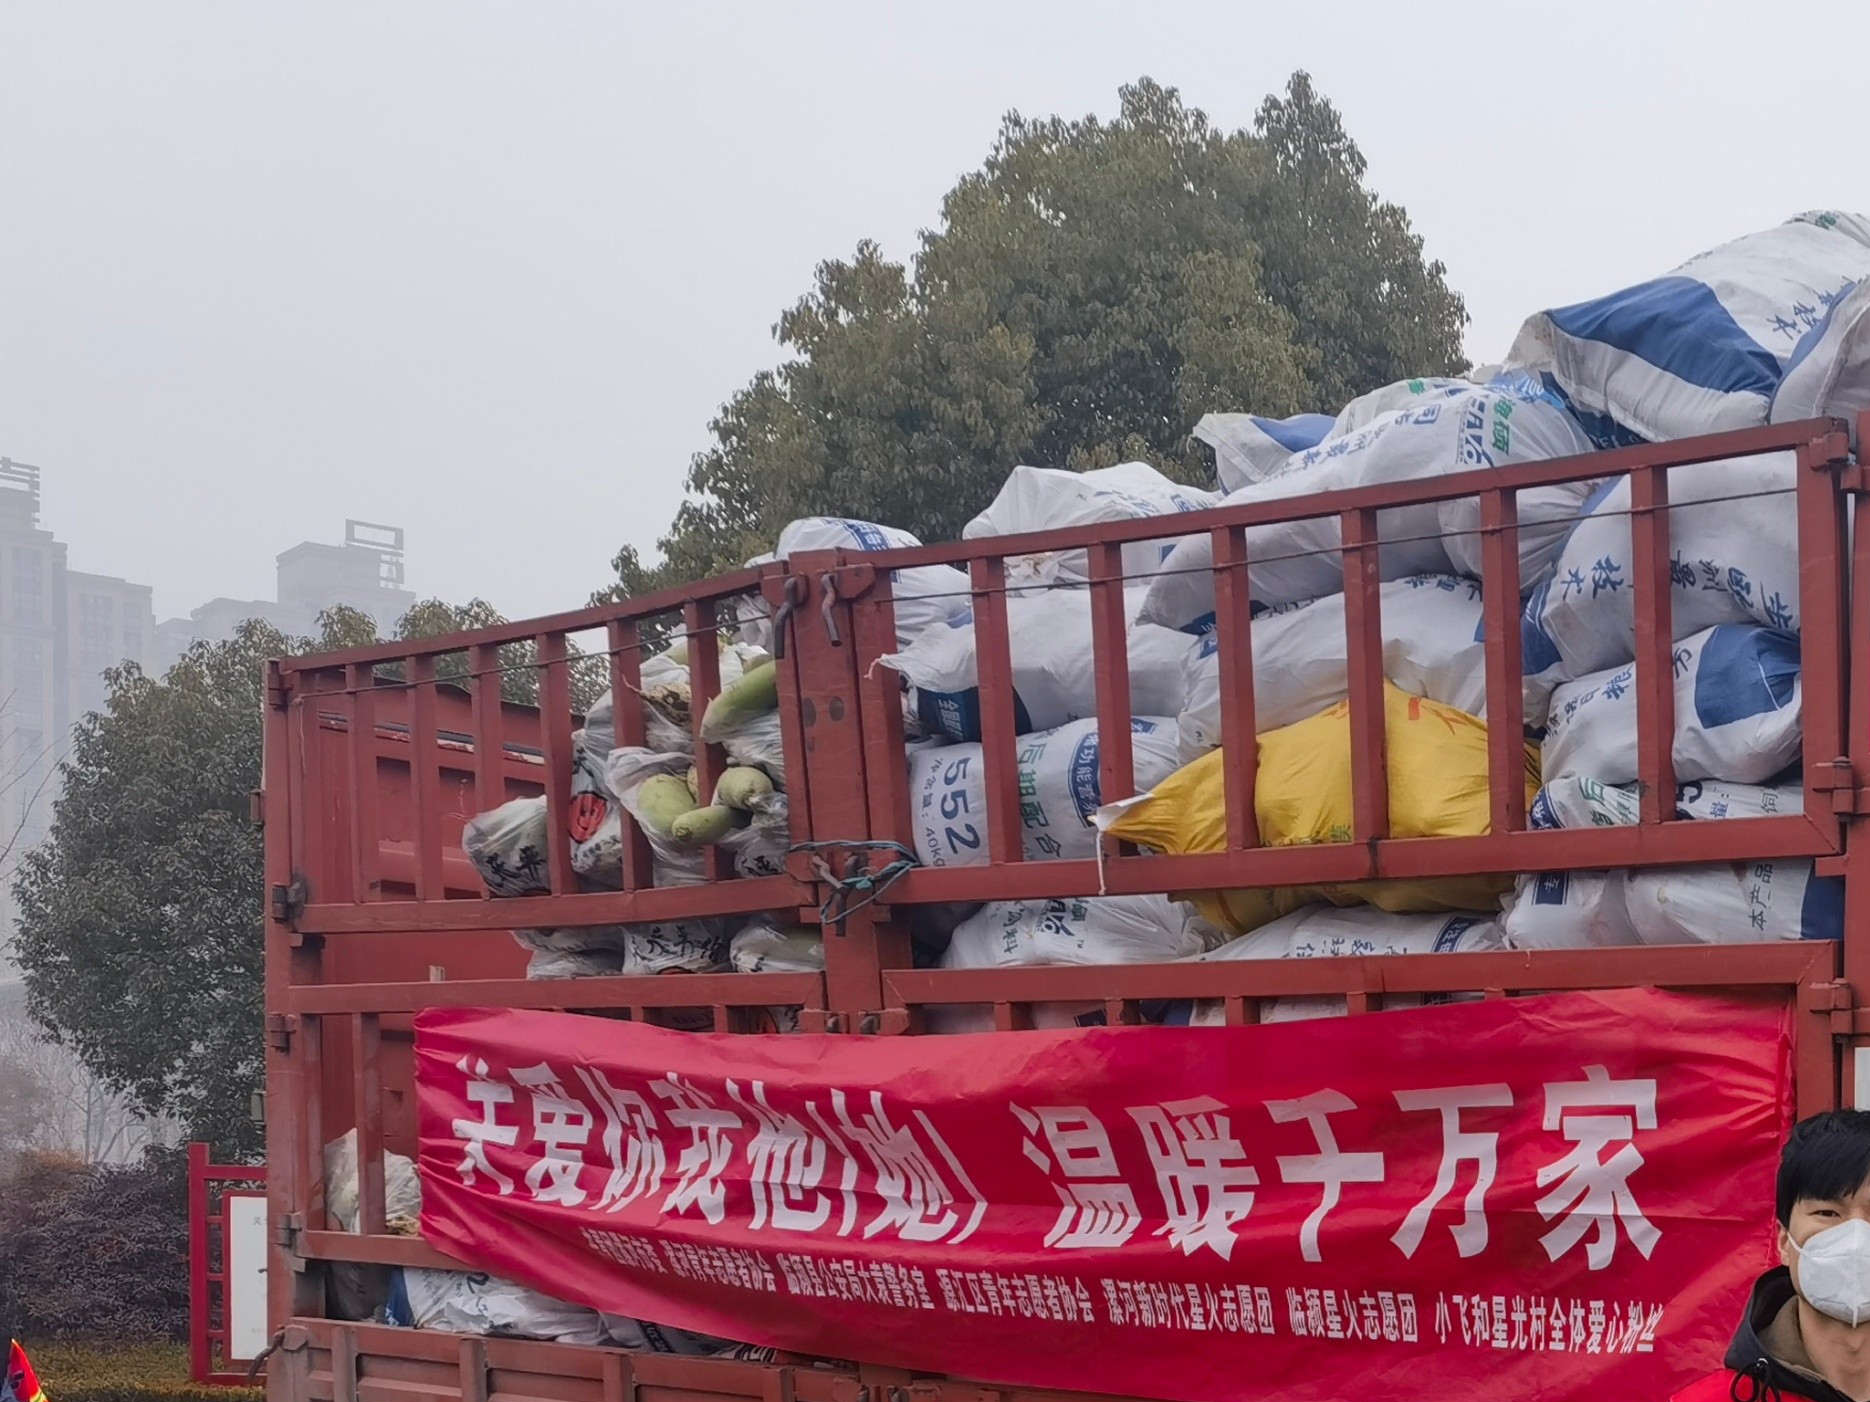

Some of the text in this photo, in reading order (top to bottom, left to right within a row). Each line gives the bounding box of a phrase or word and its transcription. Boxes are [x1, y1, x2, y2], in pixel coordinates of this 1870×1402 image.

[941, 757, 980, 855] 552
[1009, 1064, 1662, 1271] 温暖千万家
[1100, 1278, 1276, 1335] 漯河新时代星火志愿团
[1285, 1286, 1419, 1343] 临颍星火志愿团
[1435, 1291, 1664, 1355] 小飞和星光村全体爱心粉丝
